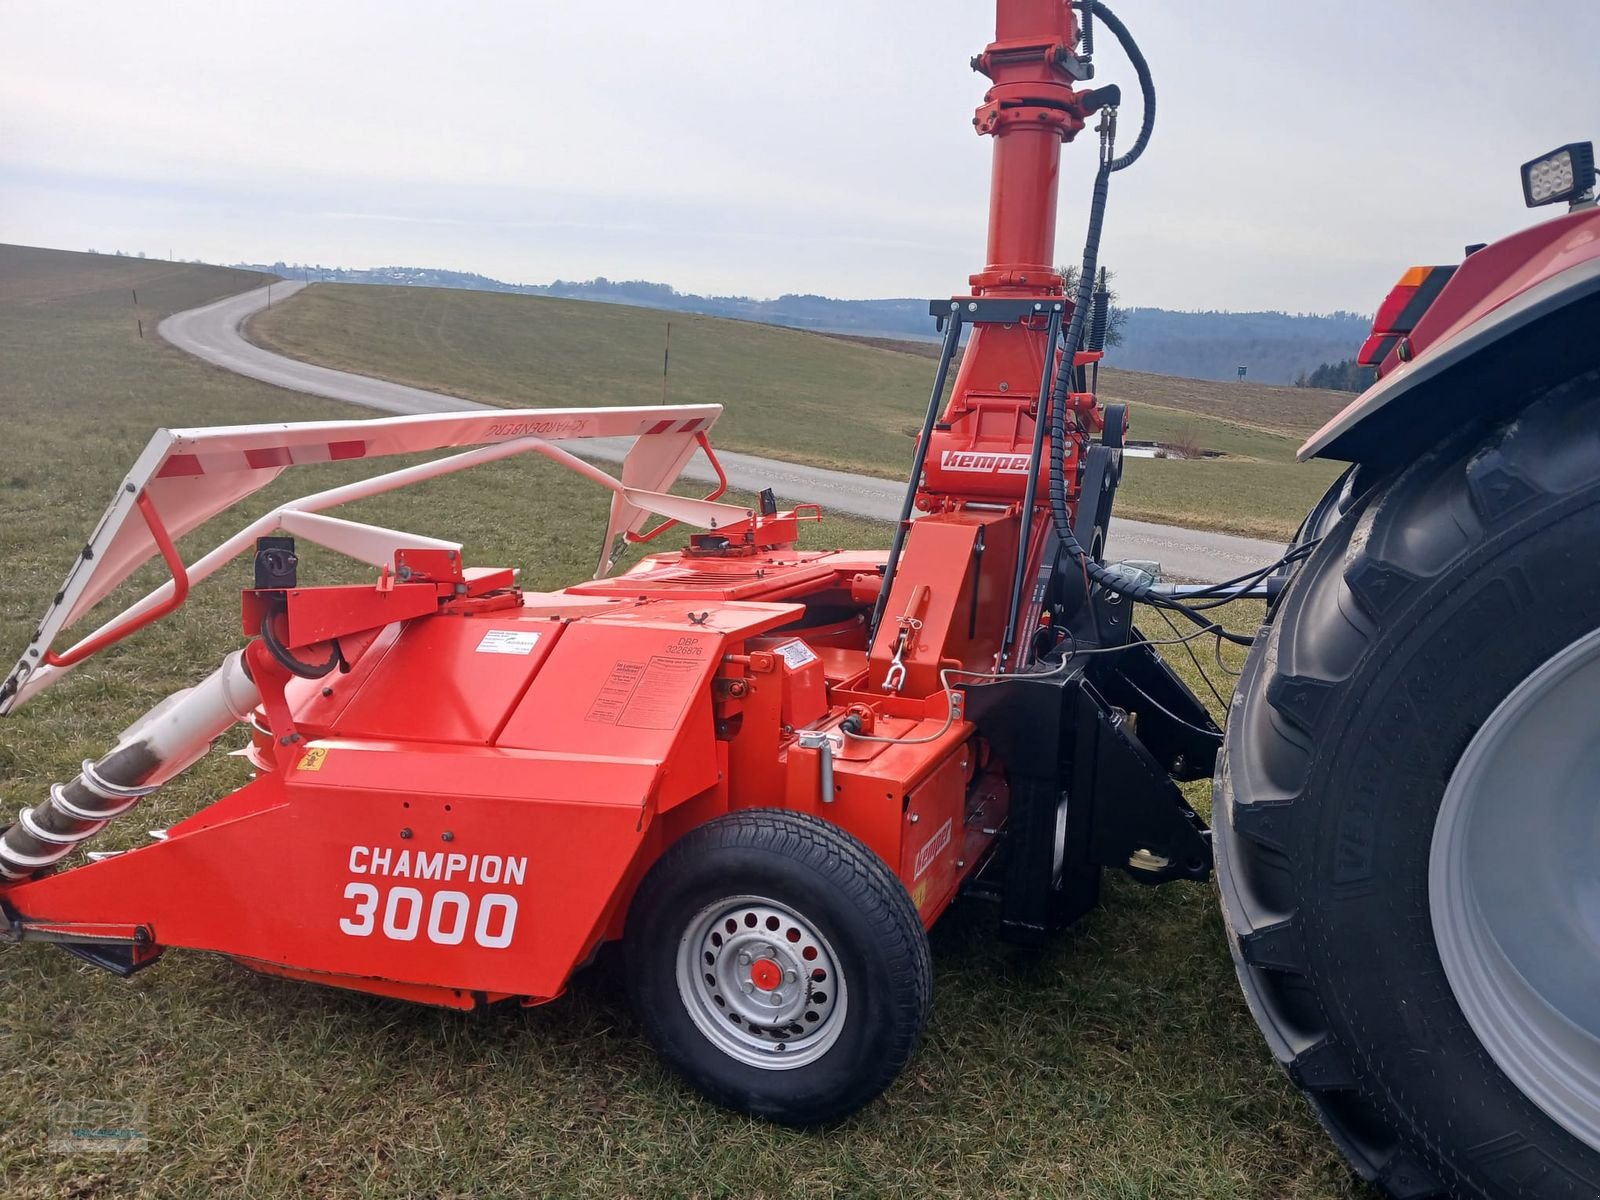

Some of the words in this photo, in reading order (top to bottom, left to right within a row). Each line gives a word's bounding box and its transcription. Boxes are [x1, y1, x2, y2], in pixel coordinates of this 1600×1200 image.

[485, 420, 588, 436] SCHARDENBERG
[678, 637, 699, 646] DBP
[348, 845, 528, 885] CHAMPION
[339, 881, 519, 949] 3000
